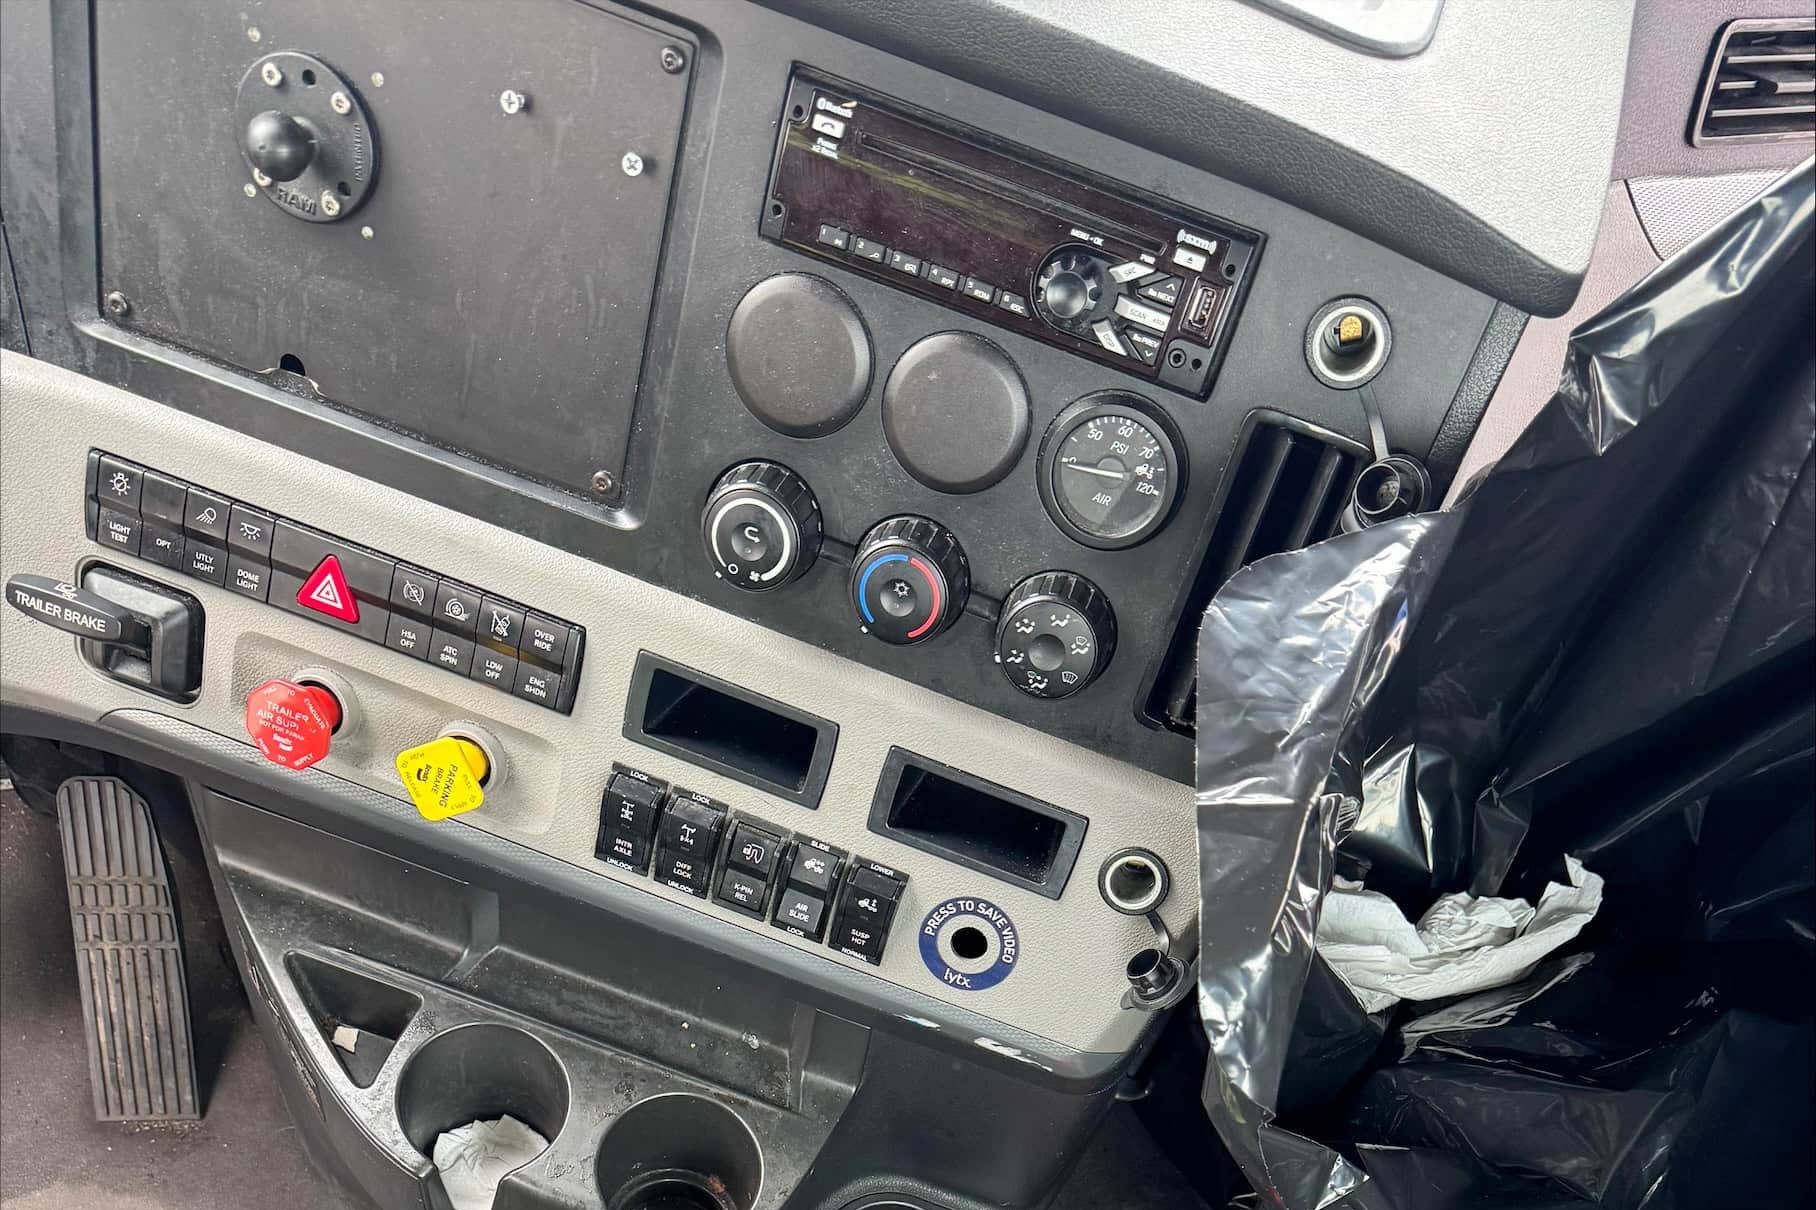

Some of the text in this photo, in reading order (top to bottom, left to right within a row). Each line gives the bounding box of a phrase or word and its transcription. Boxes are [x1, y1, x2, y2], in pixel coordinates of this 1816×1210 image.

[1158, 291, 1176, 303] NEXT
[1130, 307, 1147, 320] SCAN
[1087, 428, 1104, 441] 50
[1117, 425, 1134, 438] 60
[1110, 440, 1130, 455] PSI
[1139, 447, 1155, 459] 70
[1135, 481, 1153, 495] 120
[1092, 492, 1112, 506] AIR
[109, 521, 132, 536] LIGHT
[110, 532, 128, 544] TEST
[155, 538, 171, 549] OPT
[195, 552, 215, 563] UTLY
[193, 560, 215, 574] LIGHT
[237, 568, 260, 583] DOME
[236, 578, 258, 592] LIGHT
[15, 590, 106, 633] TRAILER BRAKE
[400, 629, 416, 641] HSA
[534, 629, 555, 643] OVER
[400, 638, 416, 650] OFF
[534, 639, 553, 652] RIDE
[443, 645, 458, 657] ATC
[440, 653, 458, 666] SPIN
[485, 659, 503, 672] LDW
[485, 669, 500, 680] OFF
[529, 676, 545, 689] ENG
[524, 684, 547, 699] SHDN
[256, 709, 274, 722] AIR
[265, 700, 310, 724] TRAILER
[431, 767, 445, 795] BRAKE
[630, 770, 649, 783] LOCK
[438, 763, 459, 808] PARKING
[691, 793, 711, 805] LOCK
[615, 837, 633, 849] INTR
[811, 840, 830, 853] SLIDE
[613, 845, 633, 857] AXLE
[606, 856, 634, 872] UNLOCK
[675, 861, 693, 871] DIFF
[870, 863, 895, 877] LOWER
[673, 868, 692, 880] LOCK
[667, 879, 694, 894] UNLOCK
[734, 883, 754, 896] K-PIN
[734, 892, 748, 903] REL
[794, 902, 809, 913] AIR
[789, 909, 810, 923] SLIDE
[786, 925, 806, 938] LOCK
[851, 928, 871, 940] SUSP
[924, 900, 1016, 964] PRESS TO SAVE VIDEO
[841, 946, 868, 962] NORMAL
[943, 967, 972, 988] lytx
